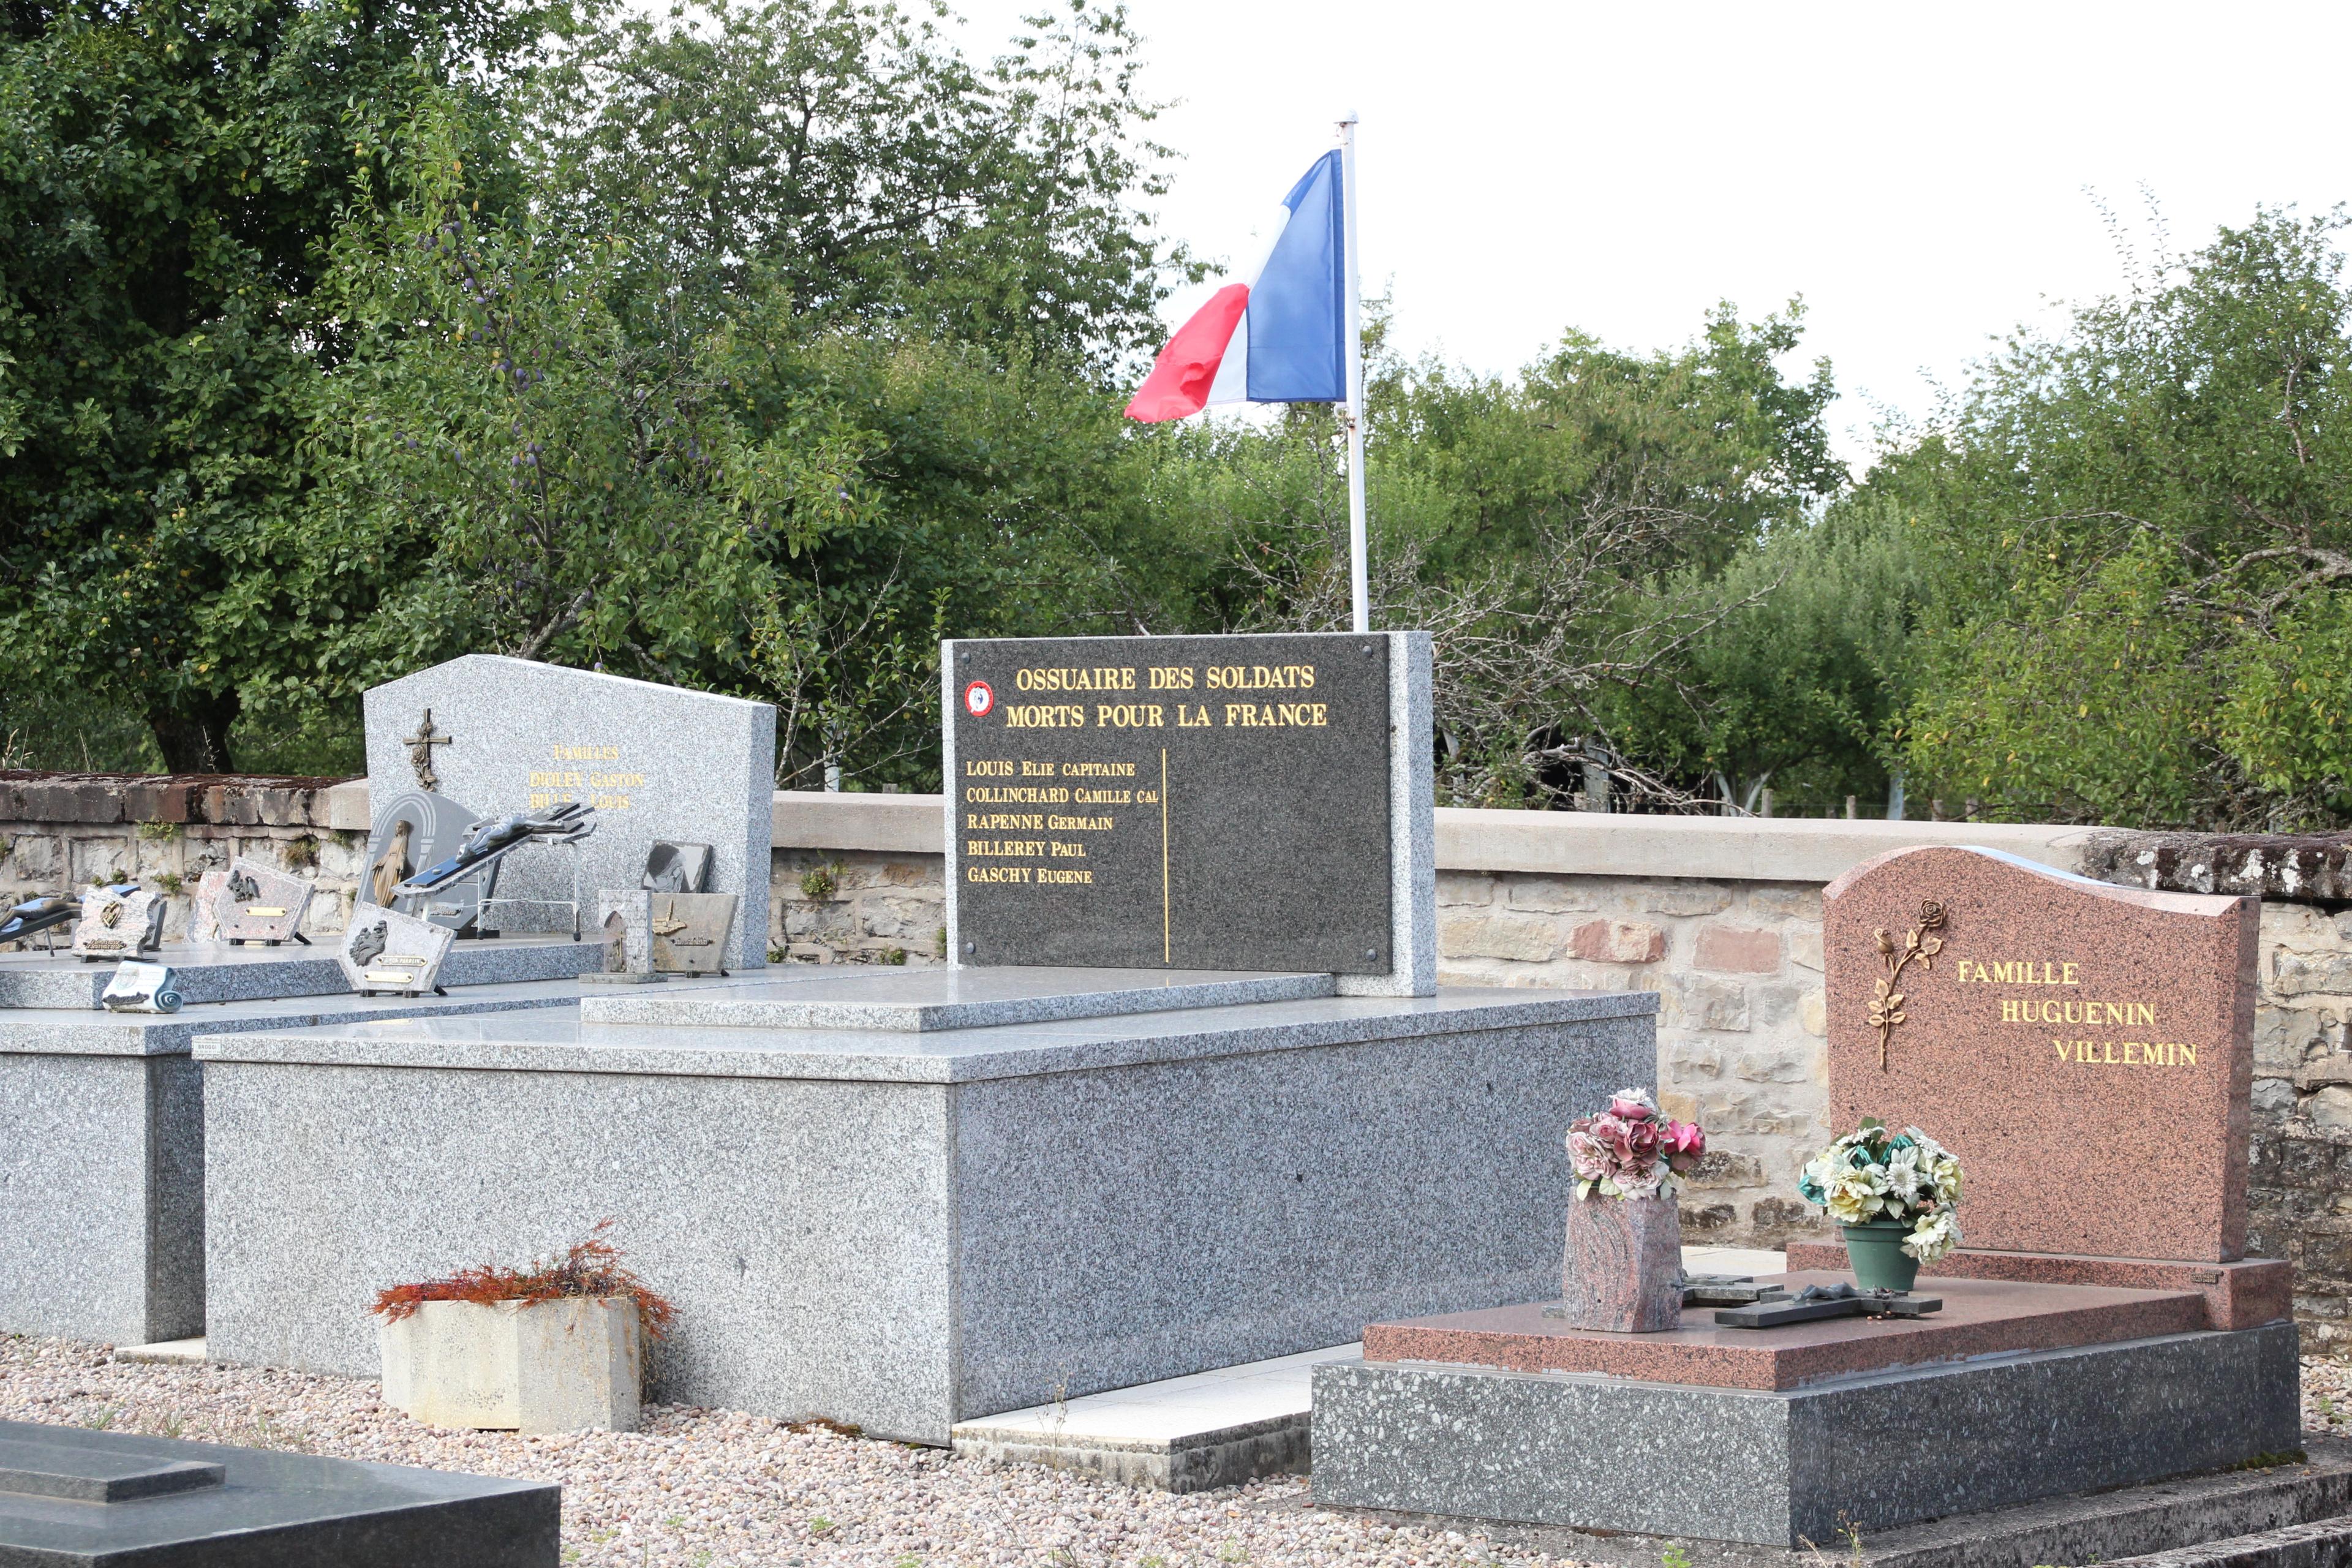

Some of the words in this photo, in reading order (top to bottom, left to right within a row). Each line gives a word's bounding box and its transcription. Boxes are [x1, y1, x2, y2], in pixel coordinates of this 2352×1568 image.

[1016, 668, 1136, 690] OSSUAIRE
[1149, 666, 1194, 689] DES
[1207, 665, 1315, 688] SOLDATS
[1006, 705, 1085, 727] MORTS
[1098, 704, 1164, 727] POUR
[1178, 704, 1212, 726] LA
[1226, 703, 1327, 726] FRANCE
[554, 744, 618, 760] FAMILLES
[967, 761, 1013, 775] LOUIS
[1022, 761, 1054, 775] ELIE
[1063, 763, 1134, 776] CAPITAINE
[590, 771, 646, 786] GASTON
[967, 788, 1069, 802] COLLINCHARD
[1076, 788, 1131, 802] CAMILLE
[967, 813, 1042, 829] RAPENNE
[1048, 815, 1112, 829] GERMAIN
[968, 841, 1045, 856] BILLEREY
[1051, 842, 1085, 856] PAUL
[968, 867, 1032, 882] GASCHY
[1037, 868, 1092, 883] EUGENE
[1958, 960, 2079, 984] FAMILLE
[2002, 1000, 2155, 1024] HUGUENIN
[2054, 1039, 2198, 1065] VILLEMIN
